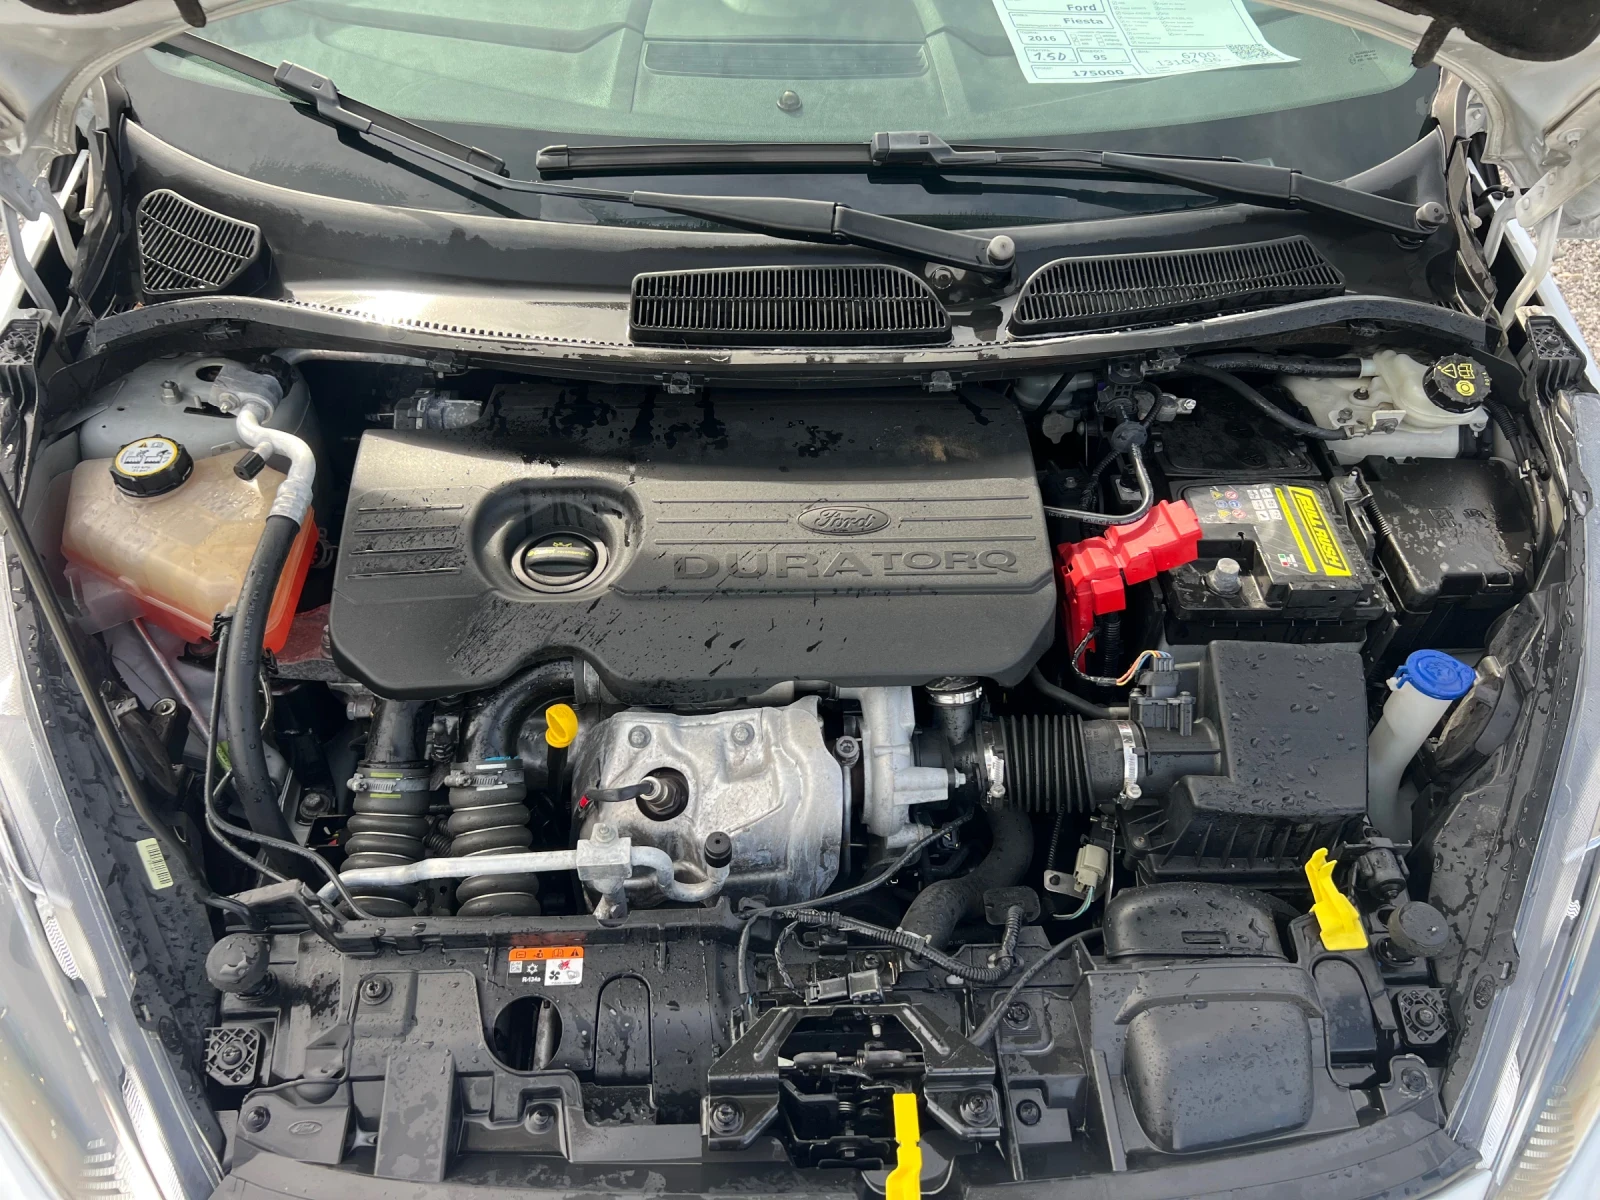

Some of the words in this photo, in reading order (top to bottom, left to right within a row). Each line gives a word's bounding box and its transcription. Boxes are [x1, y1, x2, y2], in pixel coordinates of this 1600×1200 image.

[1066, 4, 1097, 12] Ford
[1063, 17, 1104, 25] Fiesta
[813, 508, 877, 531] Ford
[1313, 525, 1342, 569] RUSH
[673, 549, 1019, 579] DURATORQ
